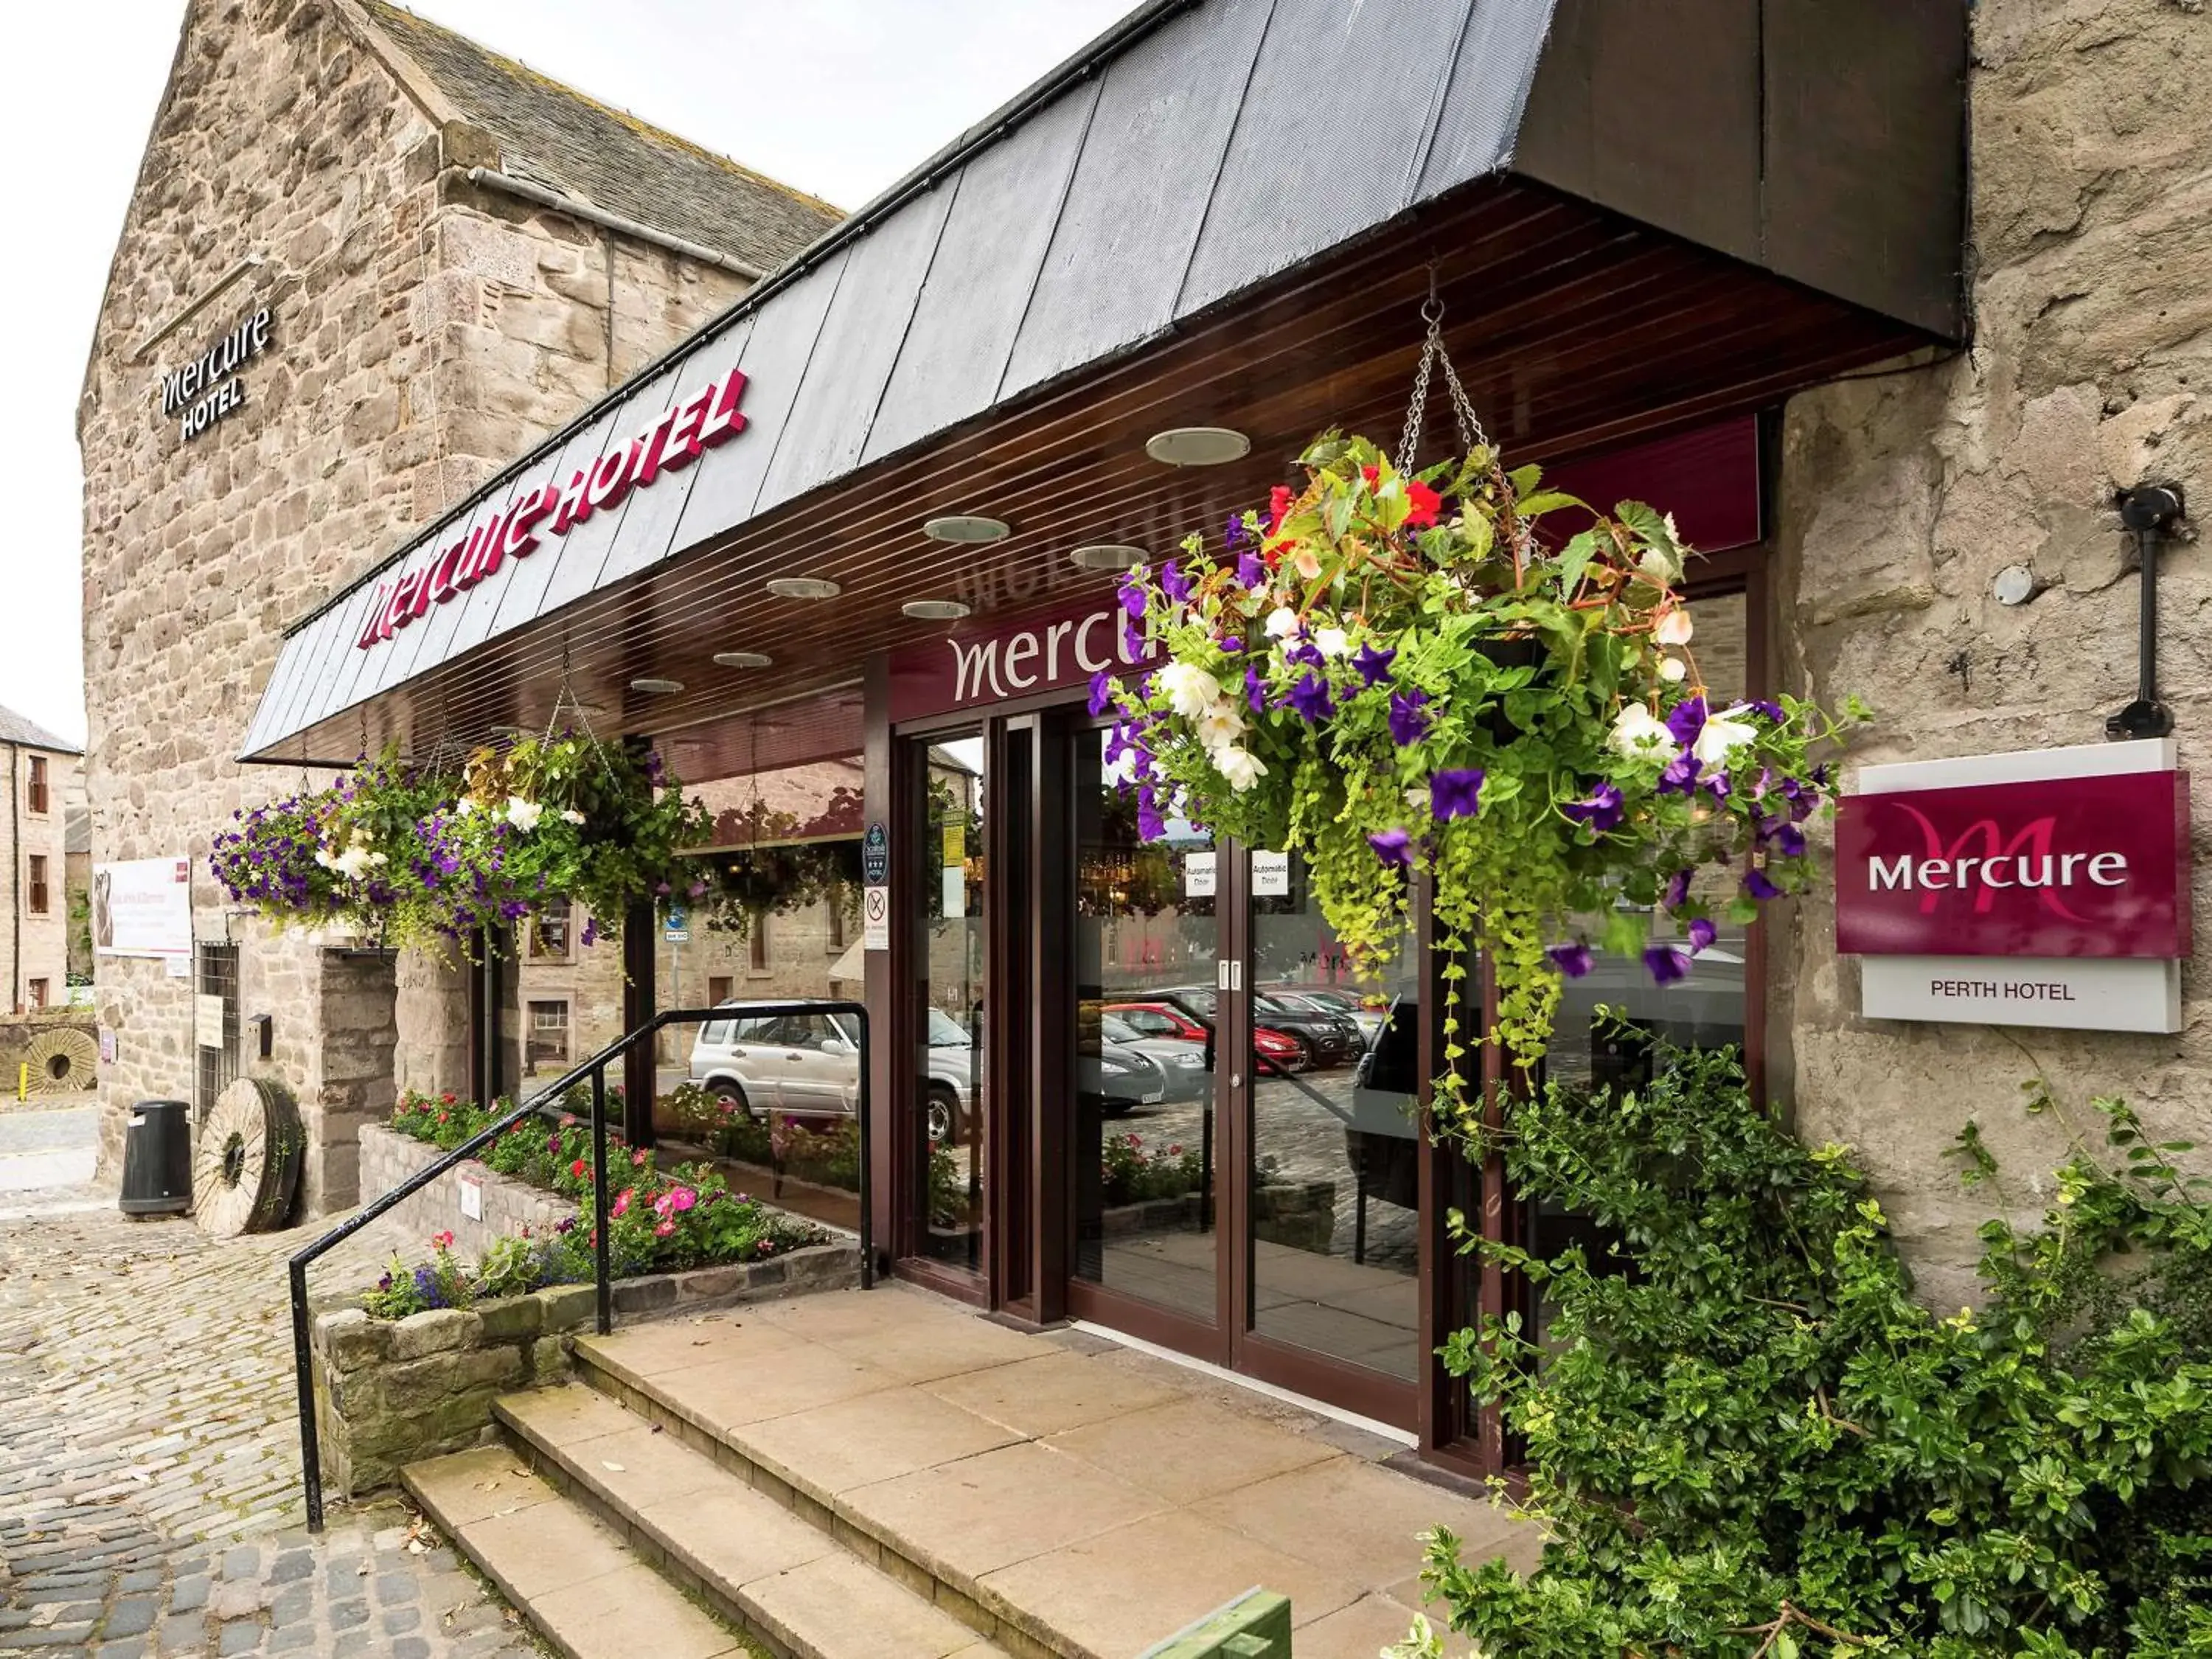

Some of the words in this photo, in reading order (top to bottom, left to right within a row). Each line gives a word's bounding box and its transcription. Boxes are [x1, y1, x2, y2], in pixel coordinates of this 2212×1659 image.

[181, 378, 243, 441] HOTEL
[549, 368, 748, 536] HOTEL
[1868, 849, 2129, 891] Mercure
[1930, 980, 1997, 998] PERTH
[2003, 981, 2076, 1002] HOTEL
